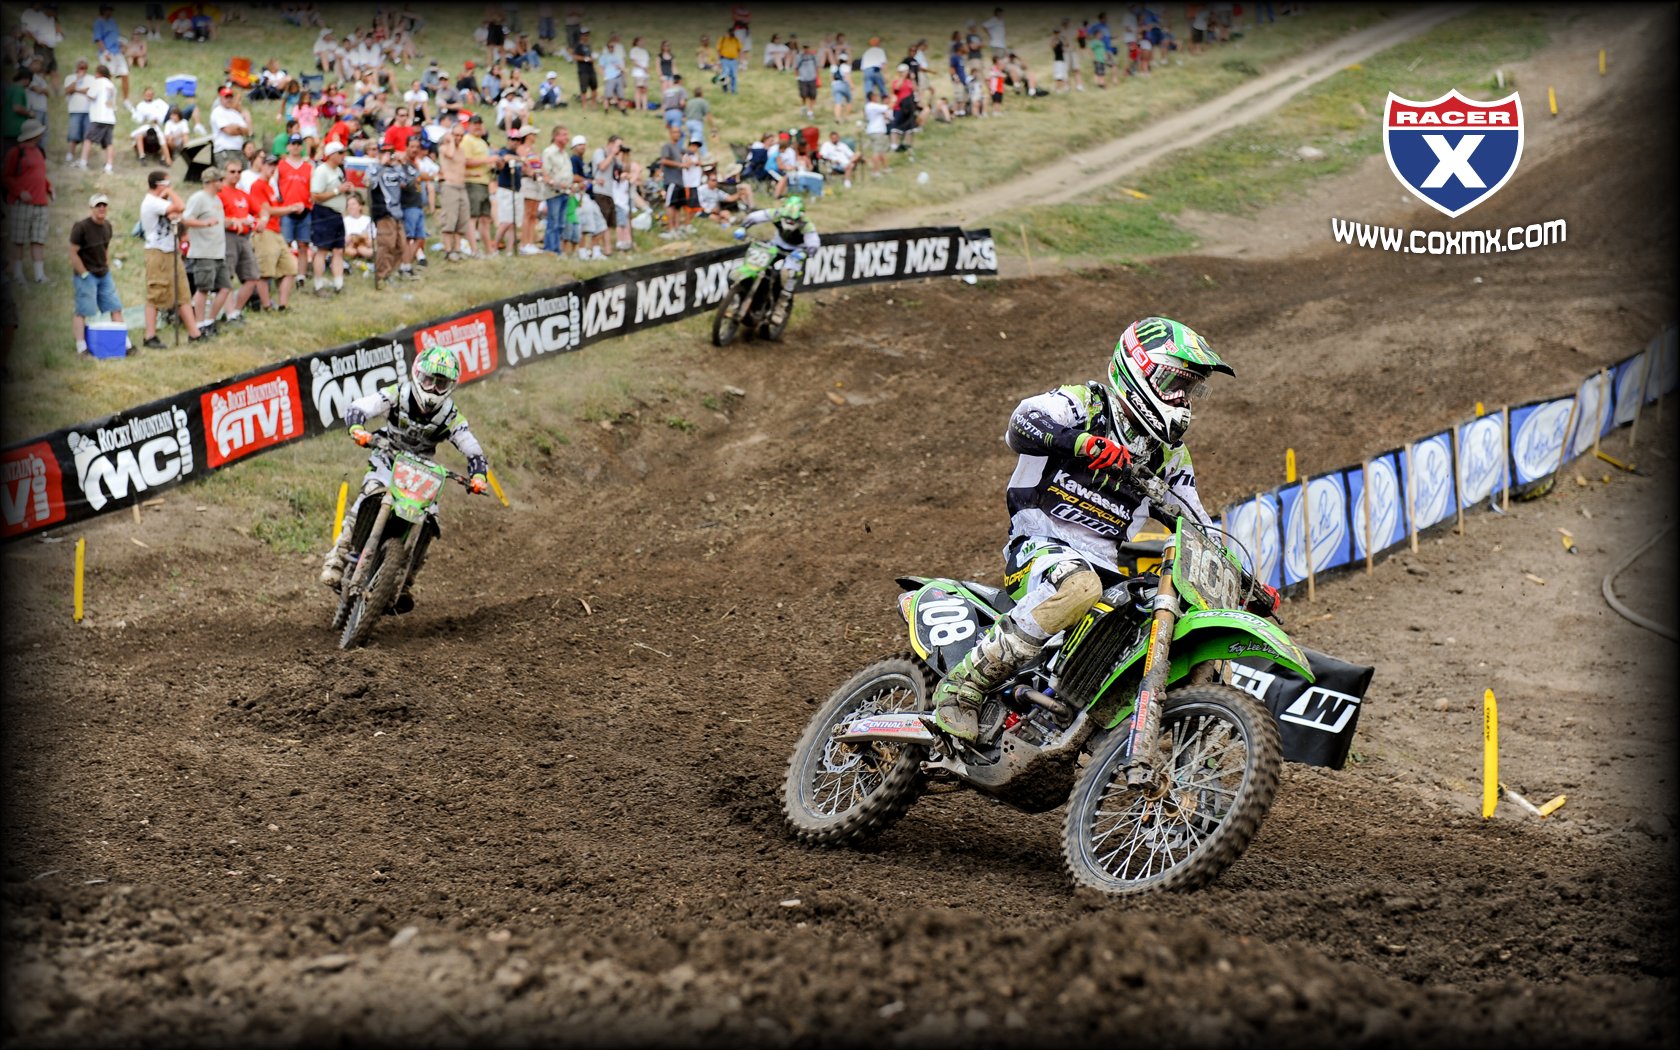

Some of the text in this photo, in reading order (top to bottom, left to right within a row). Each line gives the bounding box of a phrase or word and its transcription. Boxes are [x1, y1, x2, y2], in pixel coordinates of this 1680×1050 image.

[803, 244, 847, 285] MXS
[852, 240, 899, 279] MXS
[904, 236, 950, 274] MXS
[634, 271, 687, 324] MXS
[693, 257, 745, 308] MX
[444, 337, 479, 373] TV
[97, 416, 174, 453] ROCKY MOUNTAIN
[217, 398, 280, 458] ATV
[1130, 390, 1165, 431] TRAXXAS
[83, 435, 182, 512] MC
[1052, 468, 1131, 521] Kawasaki
[1046, 485, 1127, 528] PRO CIRCUIT
[918, 598, 976, 647] 108
[1228, 642, 1247, 656] Troy
[1247, 641, 1262, 651] Lee
